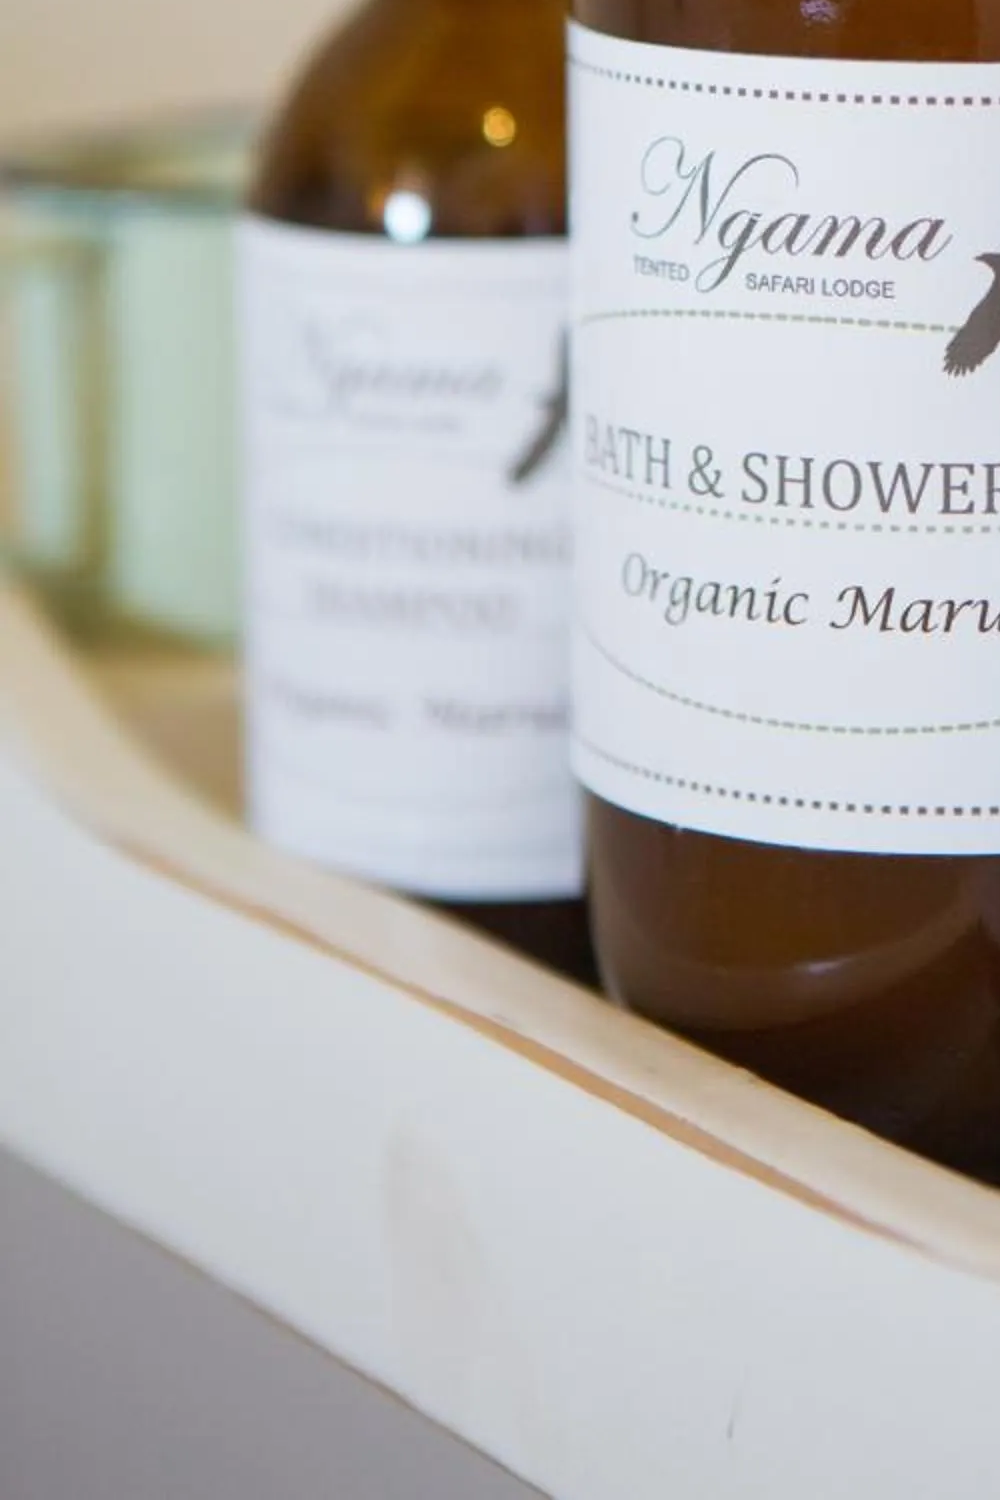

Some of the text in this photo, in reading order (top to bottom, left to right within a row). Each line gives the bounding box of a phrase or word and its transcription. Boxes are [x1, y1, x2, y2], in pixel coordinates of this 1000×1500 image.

[630, 135, 954, 294] Ngama
[633, 254, 896, 300] TENTED SAFARI LODGE
[584, 412, 673, 490] BATH
[687, 444, 726, 500] &
[621, 552, 810, 627] Organic
